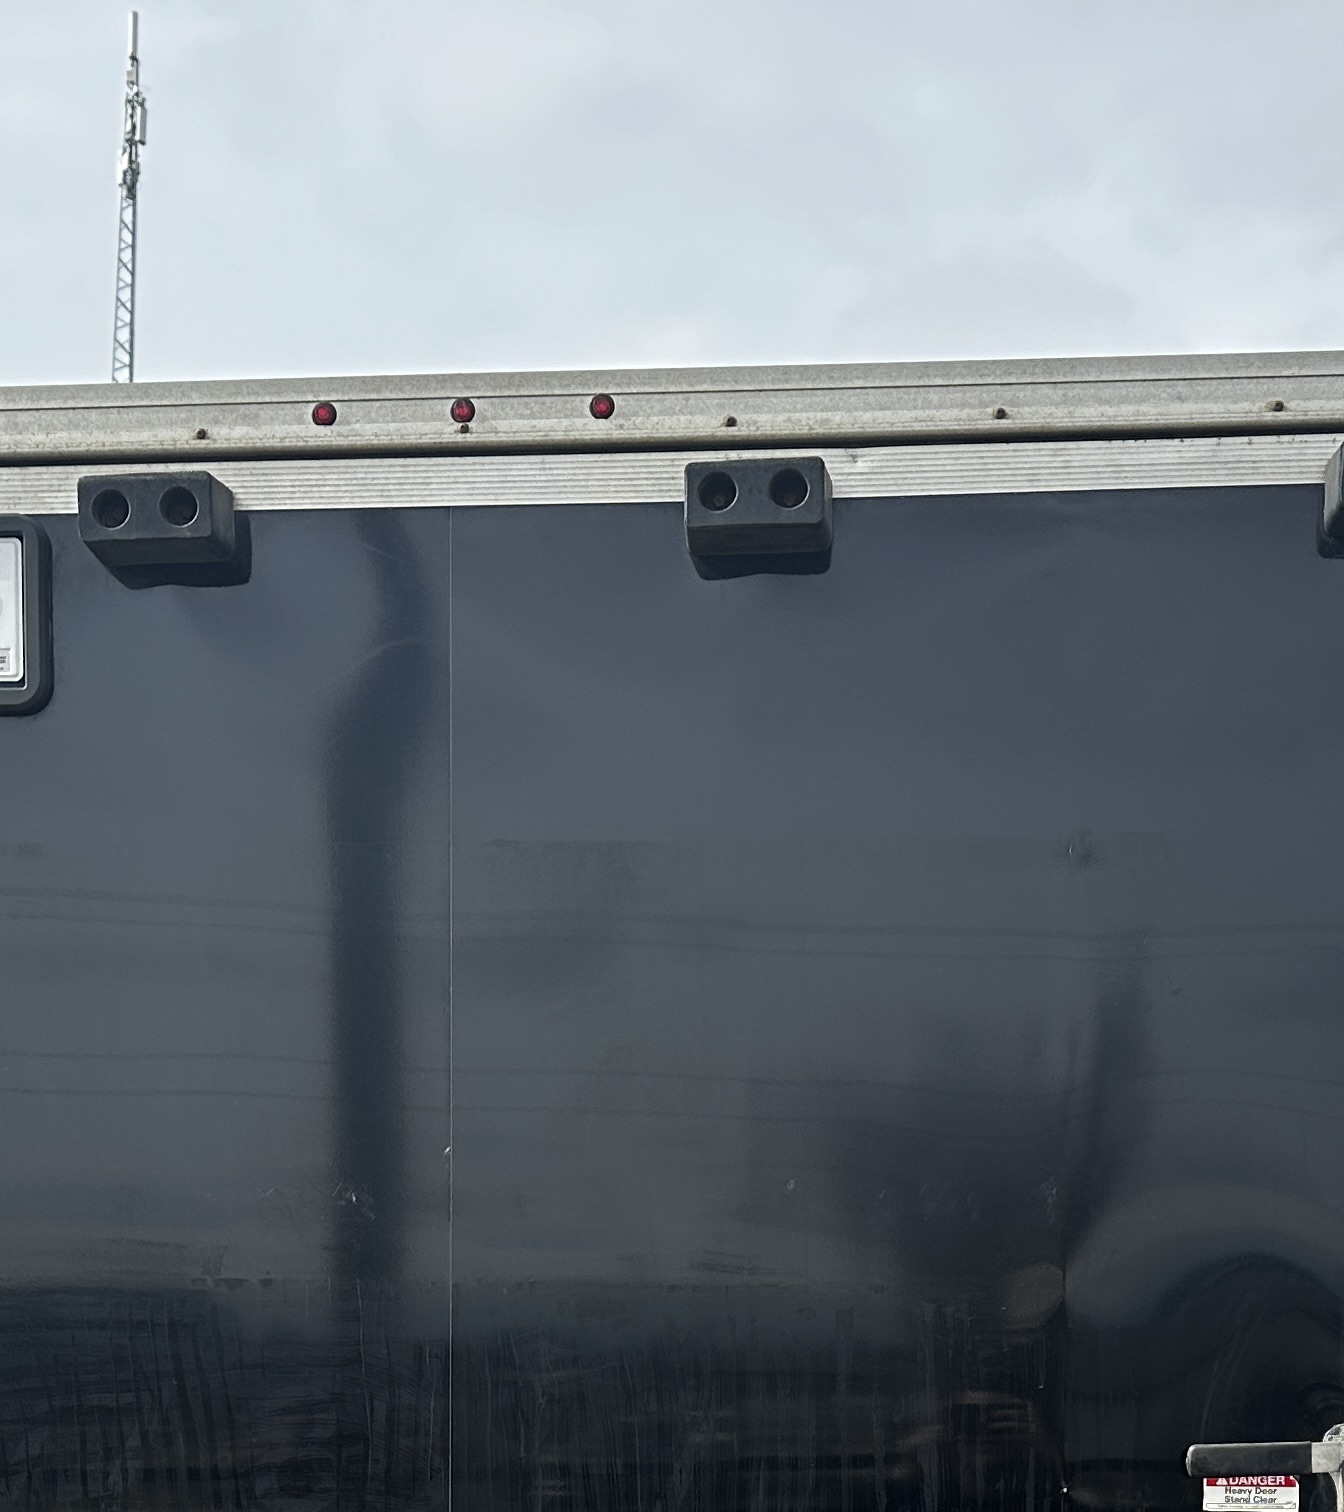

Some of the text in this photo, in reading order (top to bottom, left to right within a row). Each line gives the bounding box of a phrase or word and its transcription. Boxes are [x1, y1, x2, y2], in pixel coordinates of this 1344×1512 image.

[1229, 1476, 1285, 1485] DANGER
[1225, 1487, 1277, 1495] Heavy Door
[1224, 1496, 1277, 1504] Stand Clear
